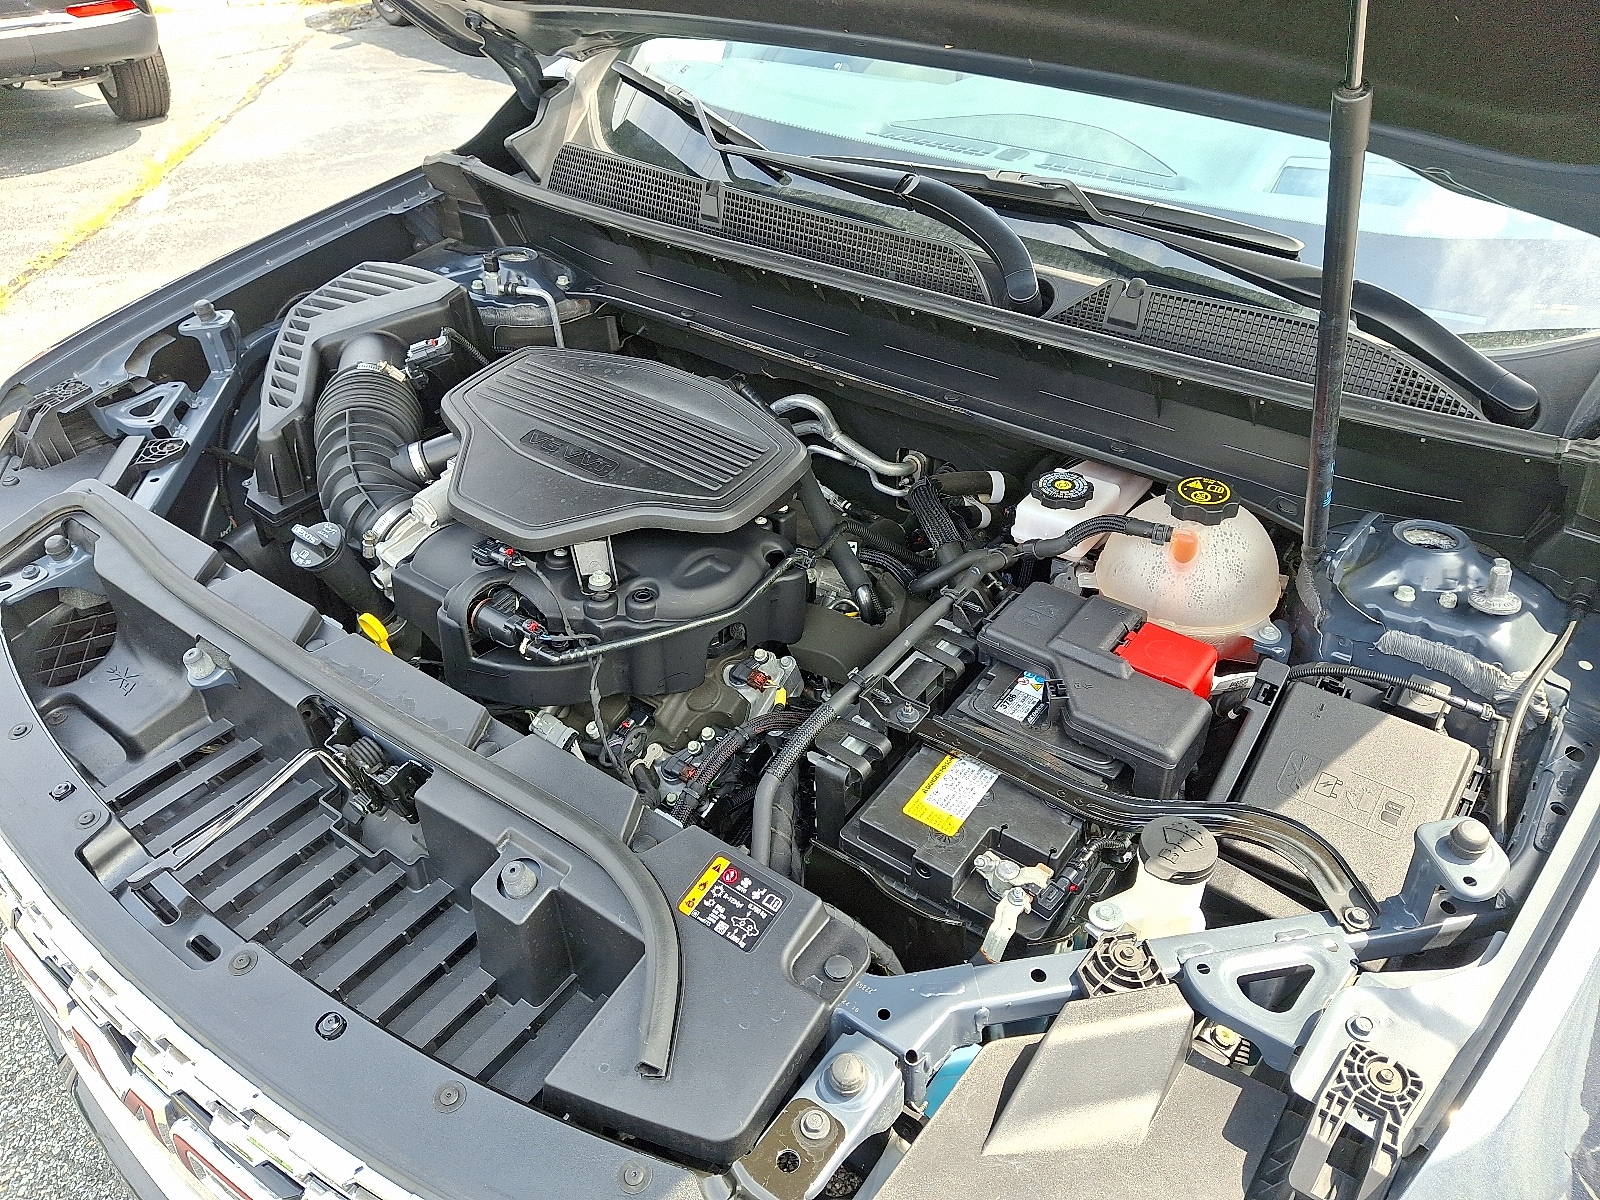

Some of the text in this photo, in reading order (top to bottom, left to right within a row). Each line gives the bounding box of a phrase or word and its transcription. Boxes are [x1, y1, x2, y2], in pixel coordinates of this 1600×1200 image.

[529, 431, 612, 472] V6 VVT
[1000, 694, 1017, 710] 3786
